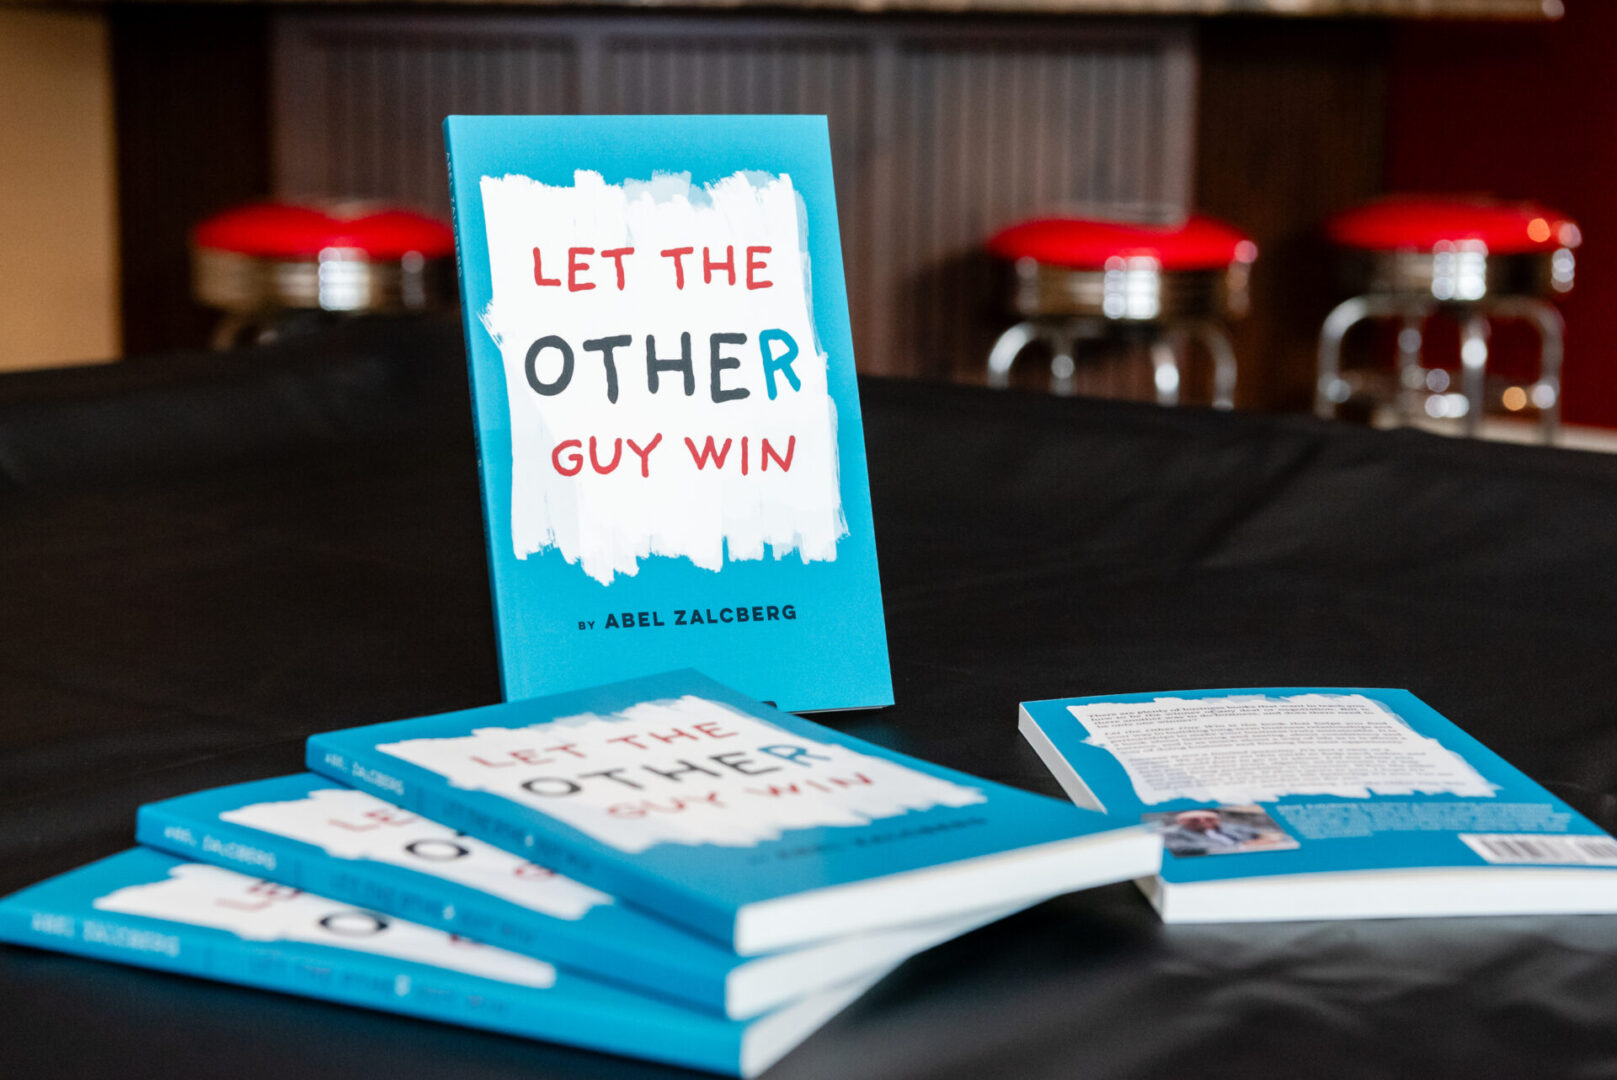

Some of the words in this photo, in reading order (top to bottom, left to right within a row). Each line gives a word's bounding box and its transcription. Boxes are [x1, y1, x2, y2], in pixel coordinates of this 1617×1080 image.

[532, 246, 635, 293] LET
[660, 245, 774, 291] THE
[524, 328, 802, 404] OTHER
[551, 432, 663, 478] GUY
[684, 434, 796, 476] WIN
[578, 620, 596, 631] BY
[604, 611, 665, 630] ABEL
[673, 604, 797, 626] ZALCBERG
[469, 743, 588, 769] LET
[606, 721, 740, 751] THE
[520, 743, 831, 798] OTHER
[743, 772, 875, 799] WIN
